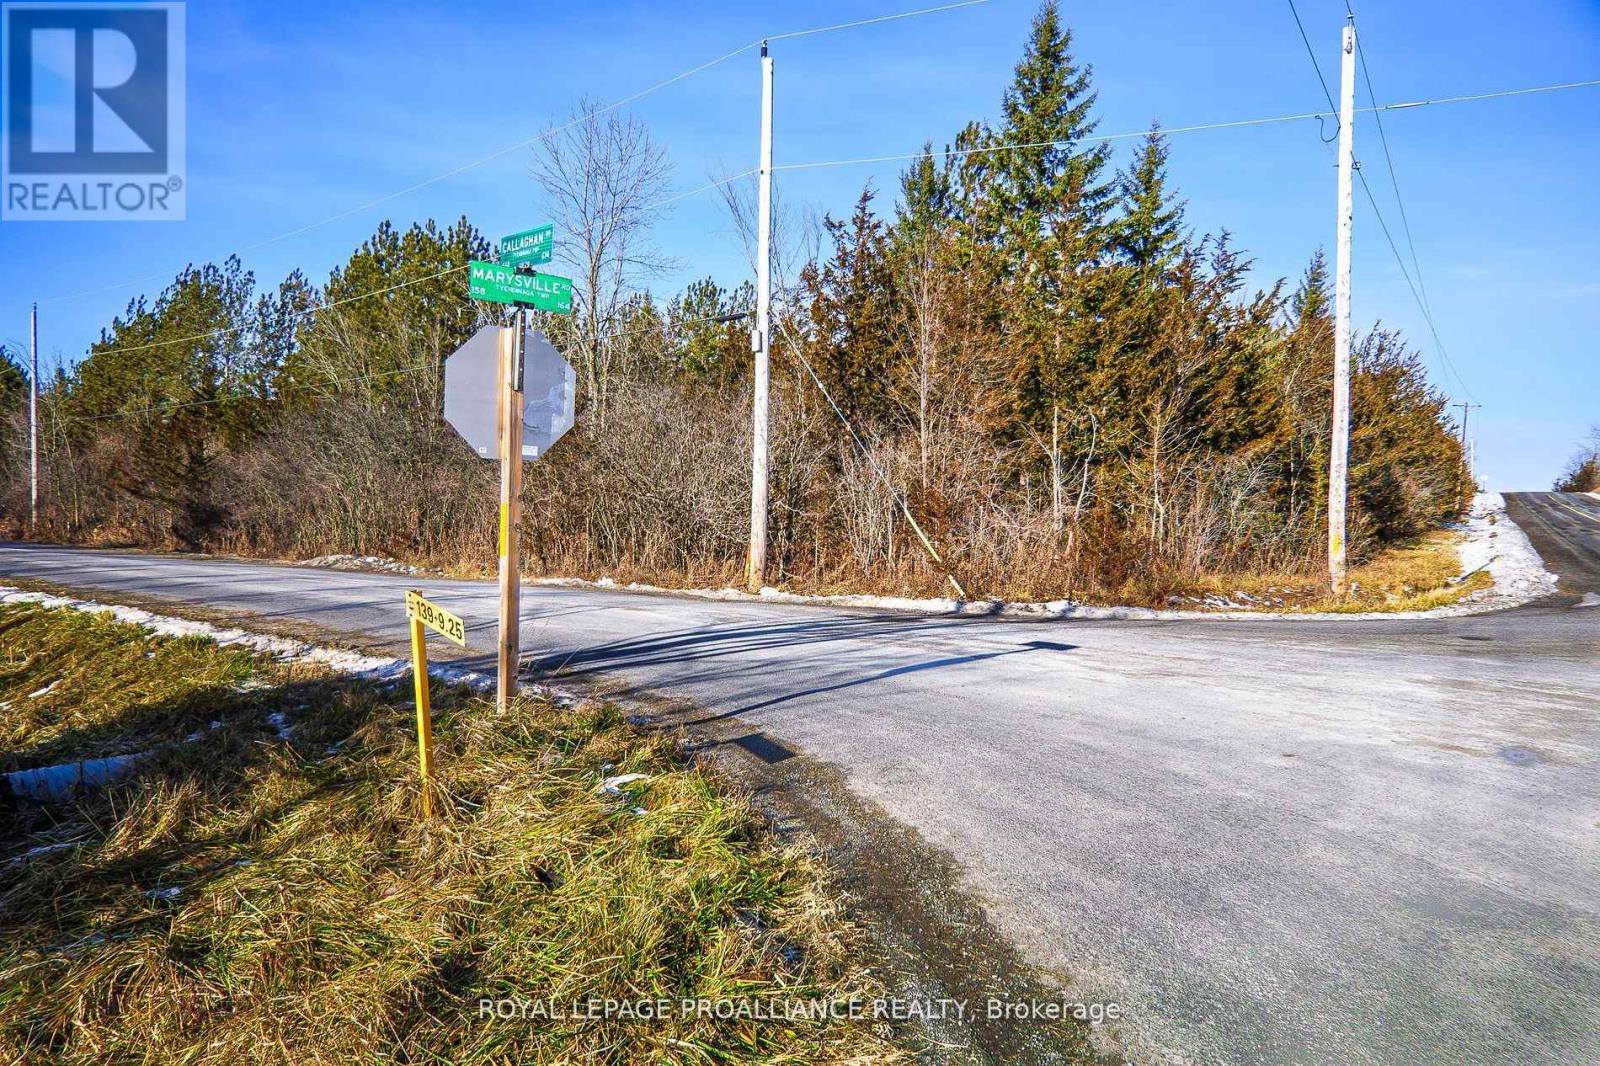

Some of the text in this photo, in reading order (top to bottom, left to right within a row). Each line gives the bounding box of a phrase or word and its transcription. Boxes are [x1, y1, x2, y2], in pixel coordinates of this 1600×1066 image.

[502, 231, 544, 253] CALLAGHAN
[471, 286, 486, 295] 158
[473, 267, 561, 294] MARYSVILLE
